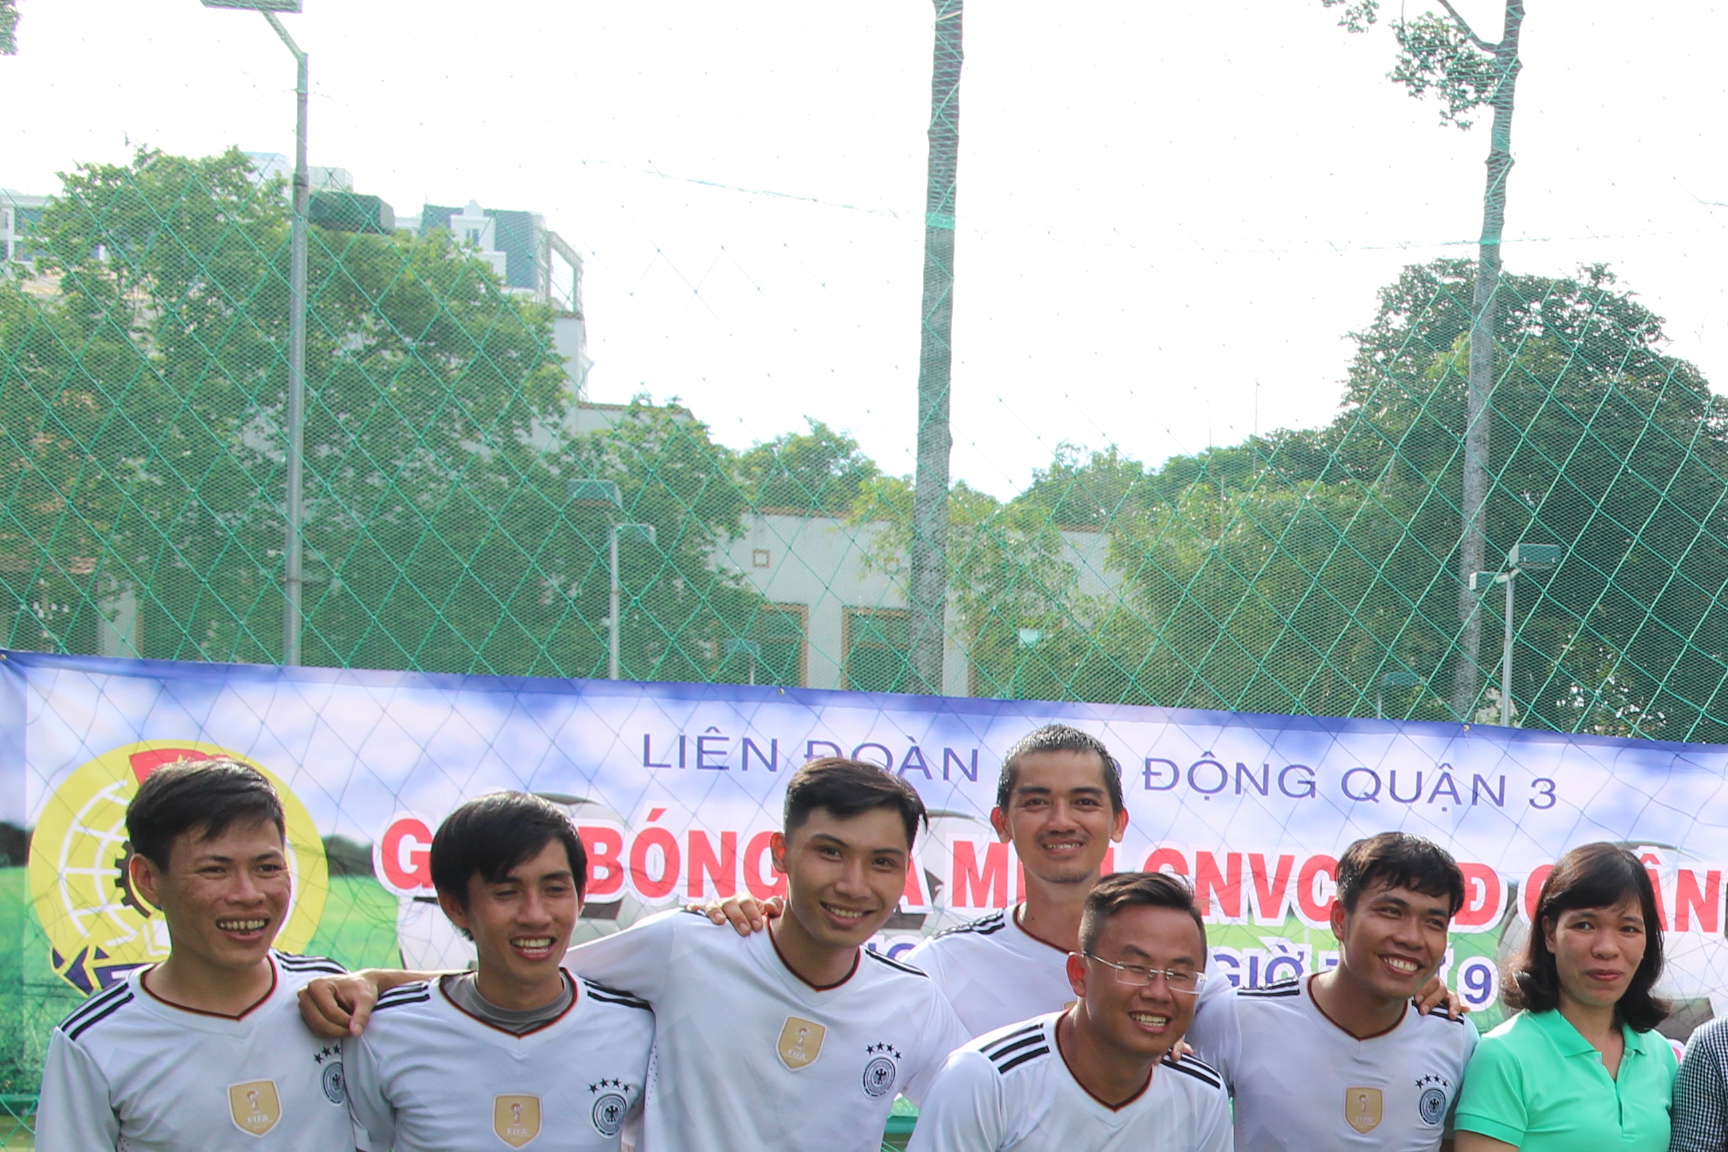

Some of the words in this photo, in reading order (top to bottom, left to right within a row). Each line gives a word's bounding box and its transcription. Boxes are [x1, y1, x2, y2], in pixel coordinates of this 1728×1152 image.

[643, 726, 778, 773] LIÊN
[1142, 751, 1317, 801] ĐỘNG
[1341, 763, 1506, 812] QUẬN
[1528, 778, 1557, 809] 3
[1464, 963, 1492, 1004] 9
